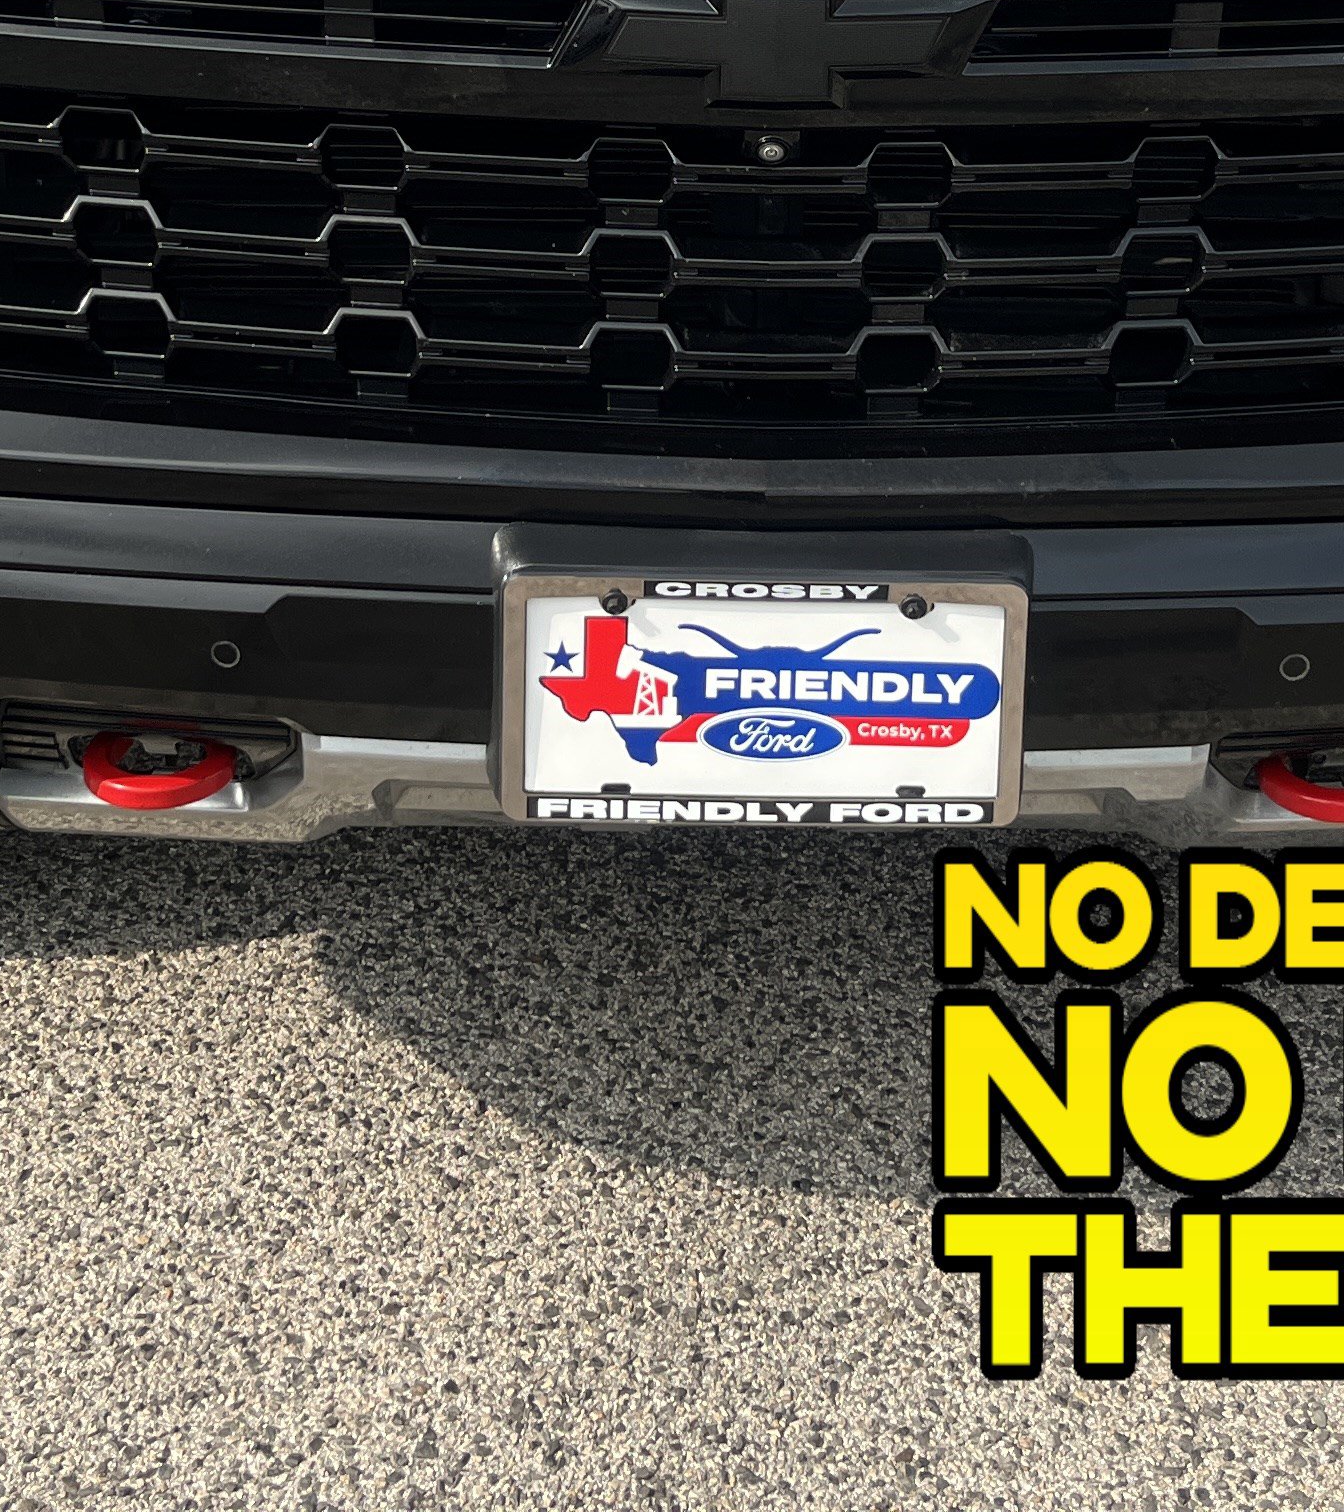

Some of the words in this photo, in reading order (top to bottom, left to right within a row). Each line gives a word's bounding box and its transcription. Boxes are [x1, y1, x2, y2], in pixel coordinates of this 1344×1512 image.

[654, 582, 880, 600] CROSBY
[704, 668, 975, 704] FRIENDLY
[729, 717, 818, 753] Ford
[857, 722, 926, 741] Crosby,
[928, 724, 954, 739] TX
[536, 798, 814, 823] FRIENDLY
[829, 802, 985, 824] FORD
